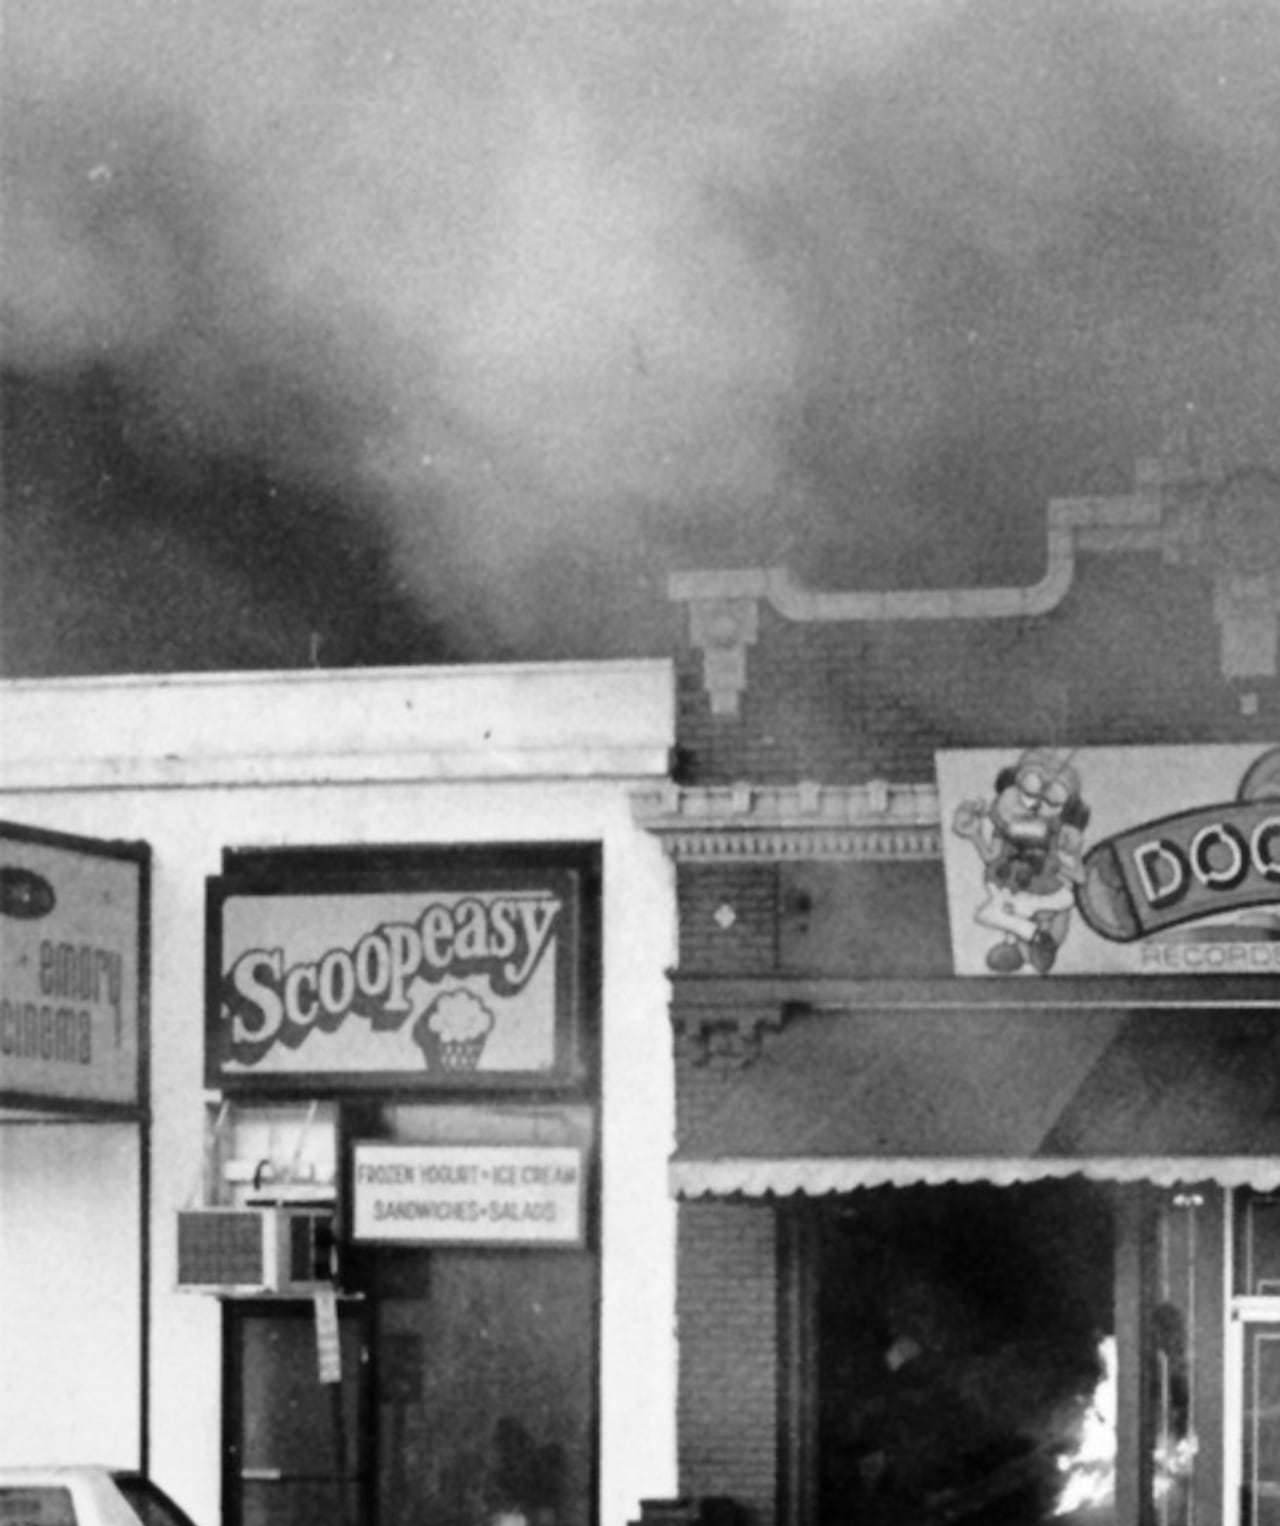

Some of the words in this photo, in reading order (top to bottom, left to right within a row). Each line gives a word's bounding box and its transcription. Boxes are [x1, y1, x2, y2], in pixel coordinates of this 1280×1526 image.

[39, 938, 123, 1049] emory
[231, 898, 561, 1046] Scoopeasy
[357, 1164, 415, 1185] FROZEN
[520, 1164, 578, 1186] CREAM
